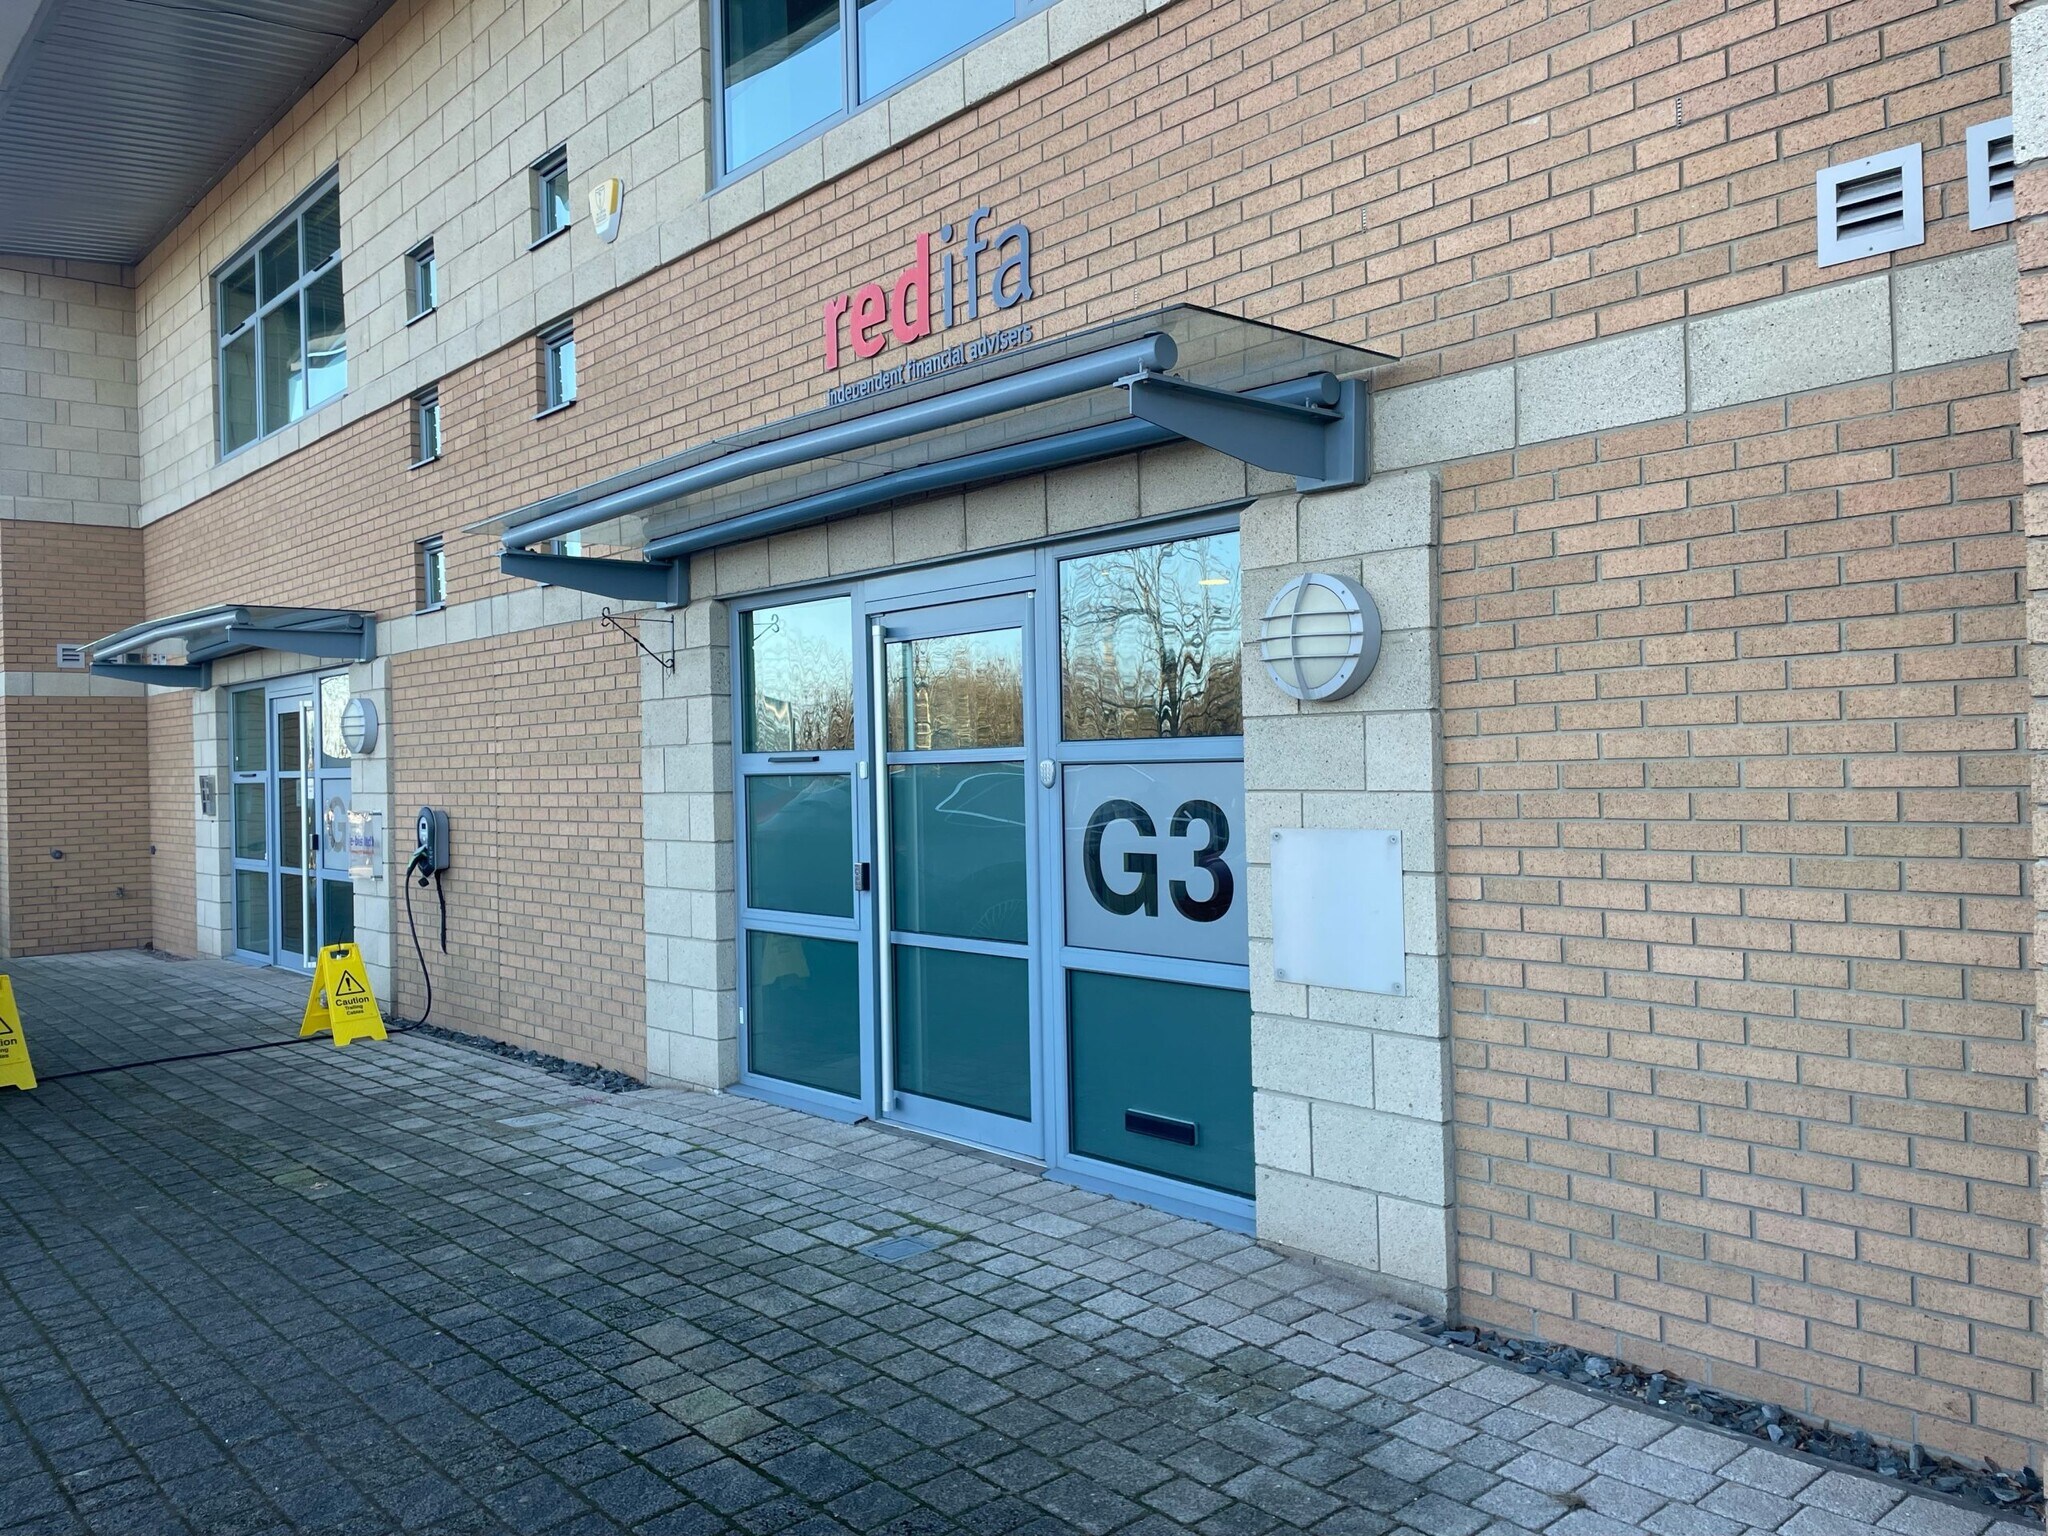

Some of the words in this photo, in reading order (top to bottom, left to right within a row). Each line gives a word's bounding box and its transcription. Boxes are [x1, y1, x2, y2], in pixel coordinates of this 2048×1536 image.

[827, 364, 905, 406] independent
[905, 343, 966, 381] financial
[968, 324, 1034, 361] advisers
[326, 796, 351, 852] G
[1082, 798, 1235, 923] G3
[335, 996, 370, 1007] Caution
